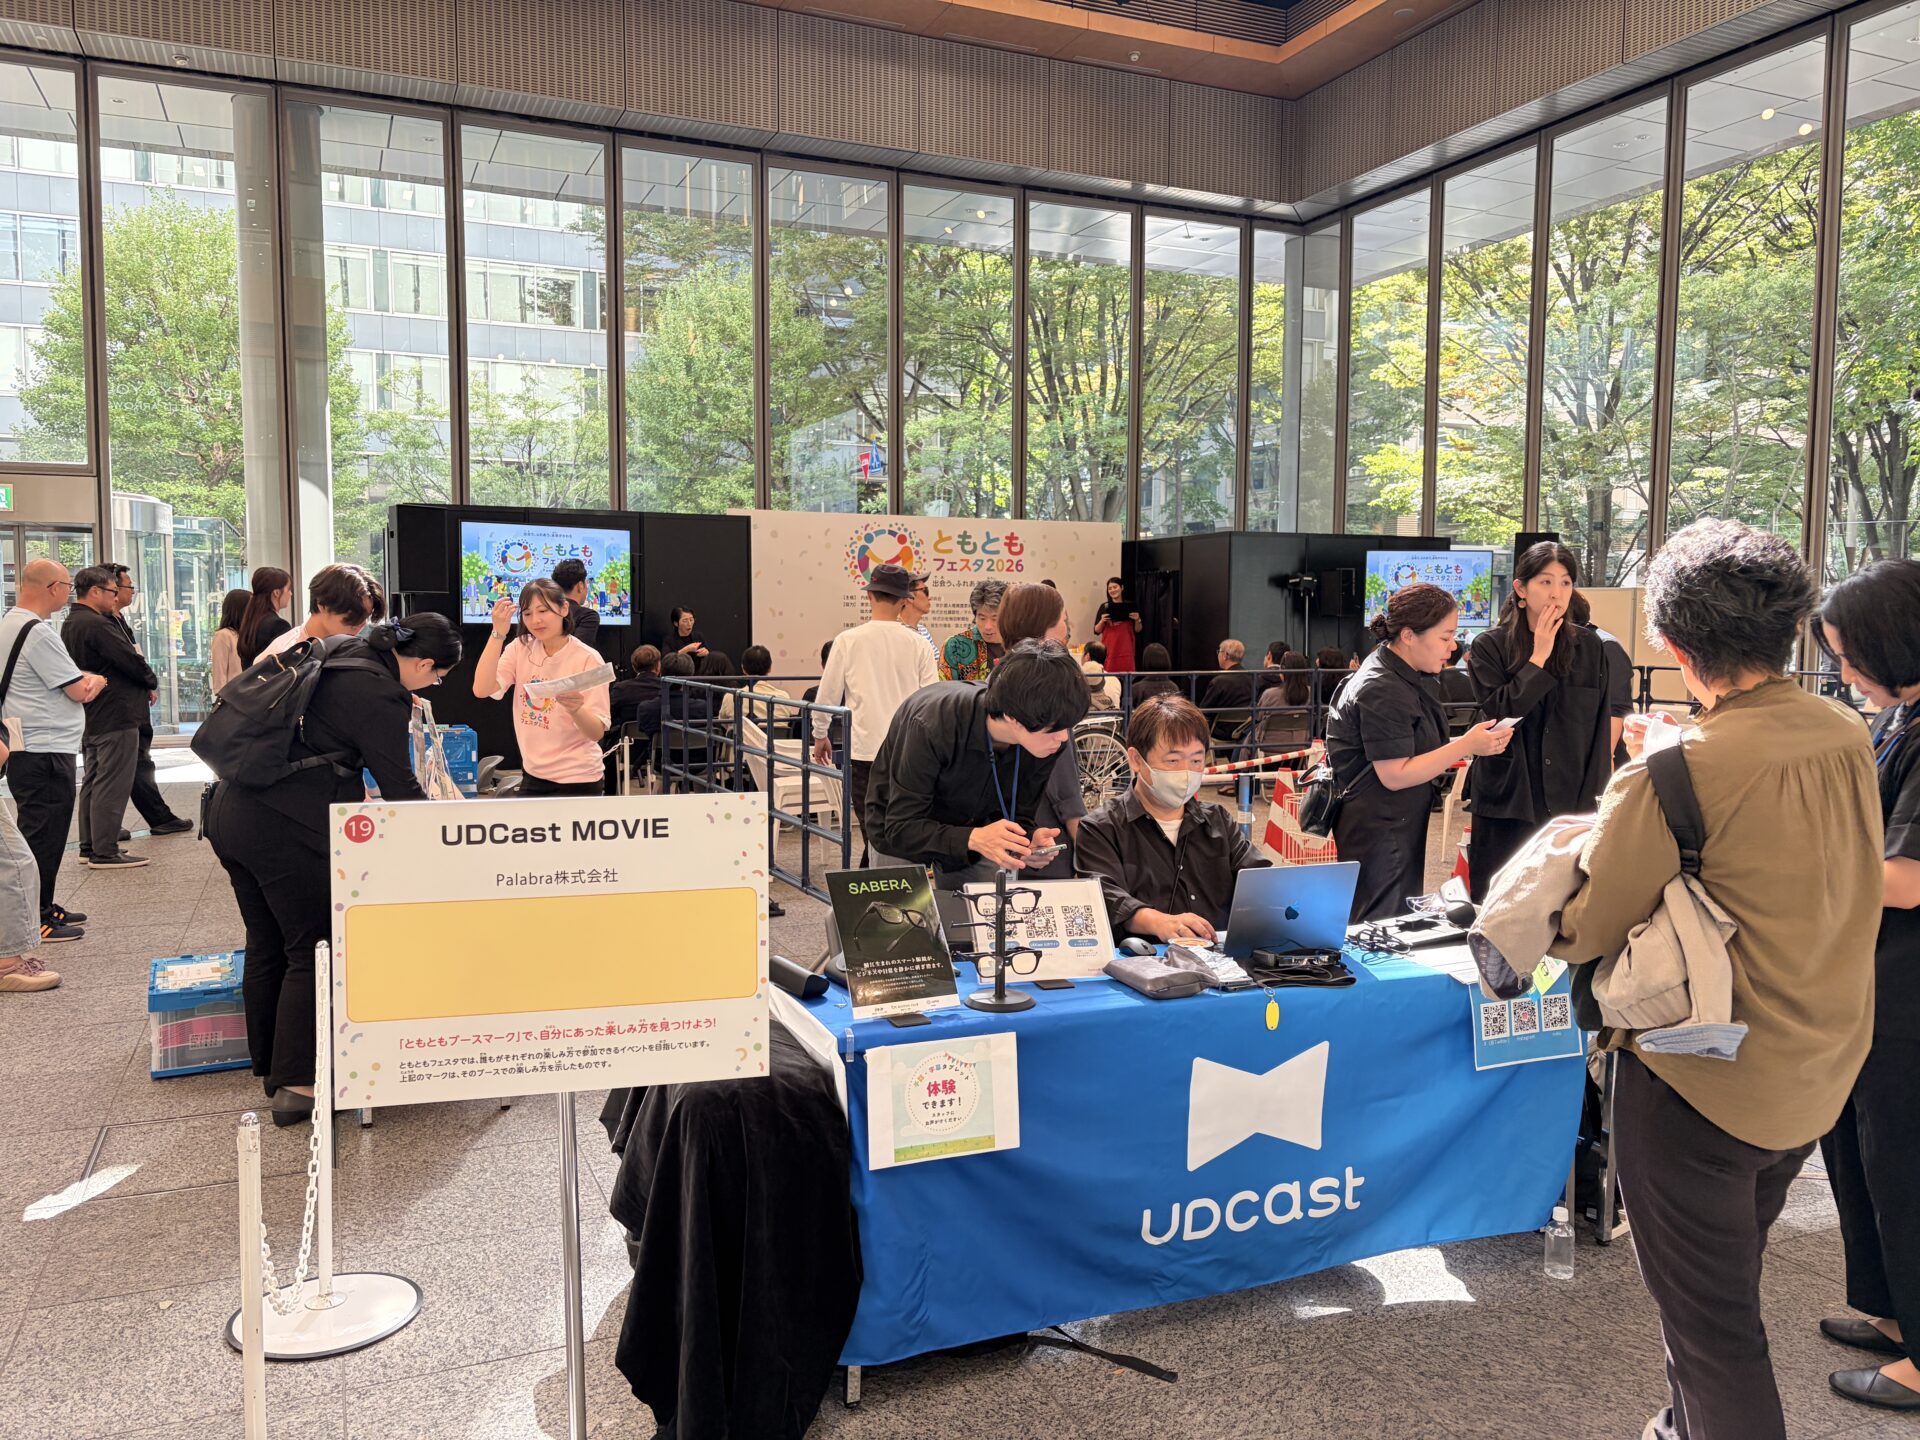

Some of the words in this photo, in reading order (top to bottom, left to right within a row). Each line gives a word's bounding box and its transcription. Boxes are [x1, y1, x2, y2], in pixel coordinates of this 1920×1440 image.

[541, 543, 593, 558] ともとも
[933, 529, 1025, 556] ともとも
[933, 558, 1025, 573] フェスタ2026
[1424, 564, 1463, 575] ともとも
[521, 710, 550, 724] ともとも
[348, 820, 373, 838] 19
[441, 822, 562, 847] UDCast
[572, 817, 670, 842] MOVIE
[496, 867, 619, 887] Palabra株式会社
[848, 878, 912, 895] SABERA
[926, 1079, 957, 1097] 体験
